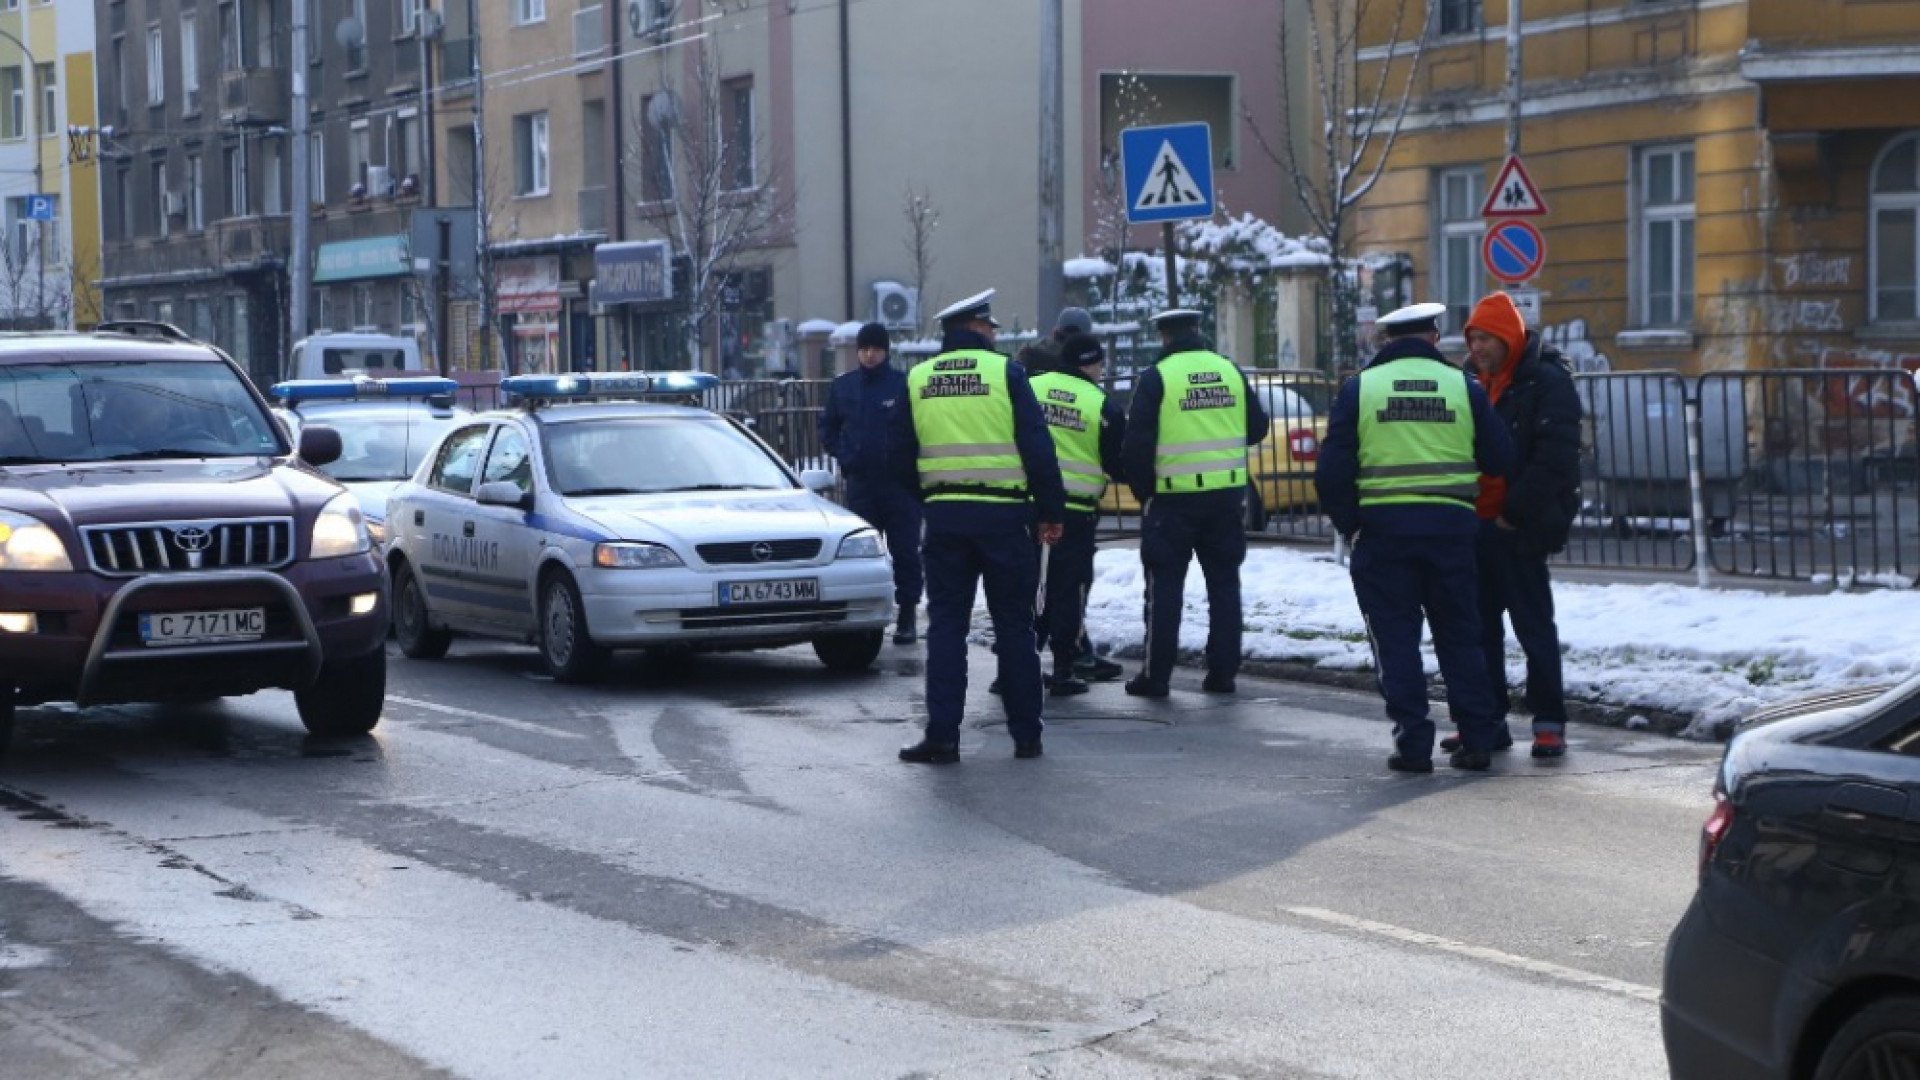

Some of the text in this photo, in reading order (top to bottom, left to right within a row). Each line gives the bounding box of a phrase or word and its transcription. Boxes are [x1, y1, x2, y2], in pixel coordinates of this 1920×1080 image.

[33, 198, 47, 216] P
[922, 384, 988, 398] ПОЛИЦИЯ
[432, 533, 498, 572] ПОЛИЦИЯ
[755, 582, 792, 600] 6743
[183, 614, 230, 635] 7171
